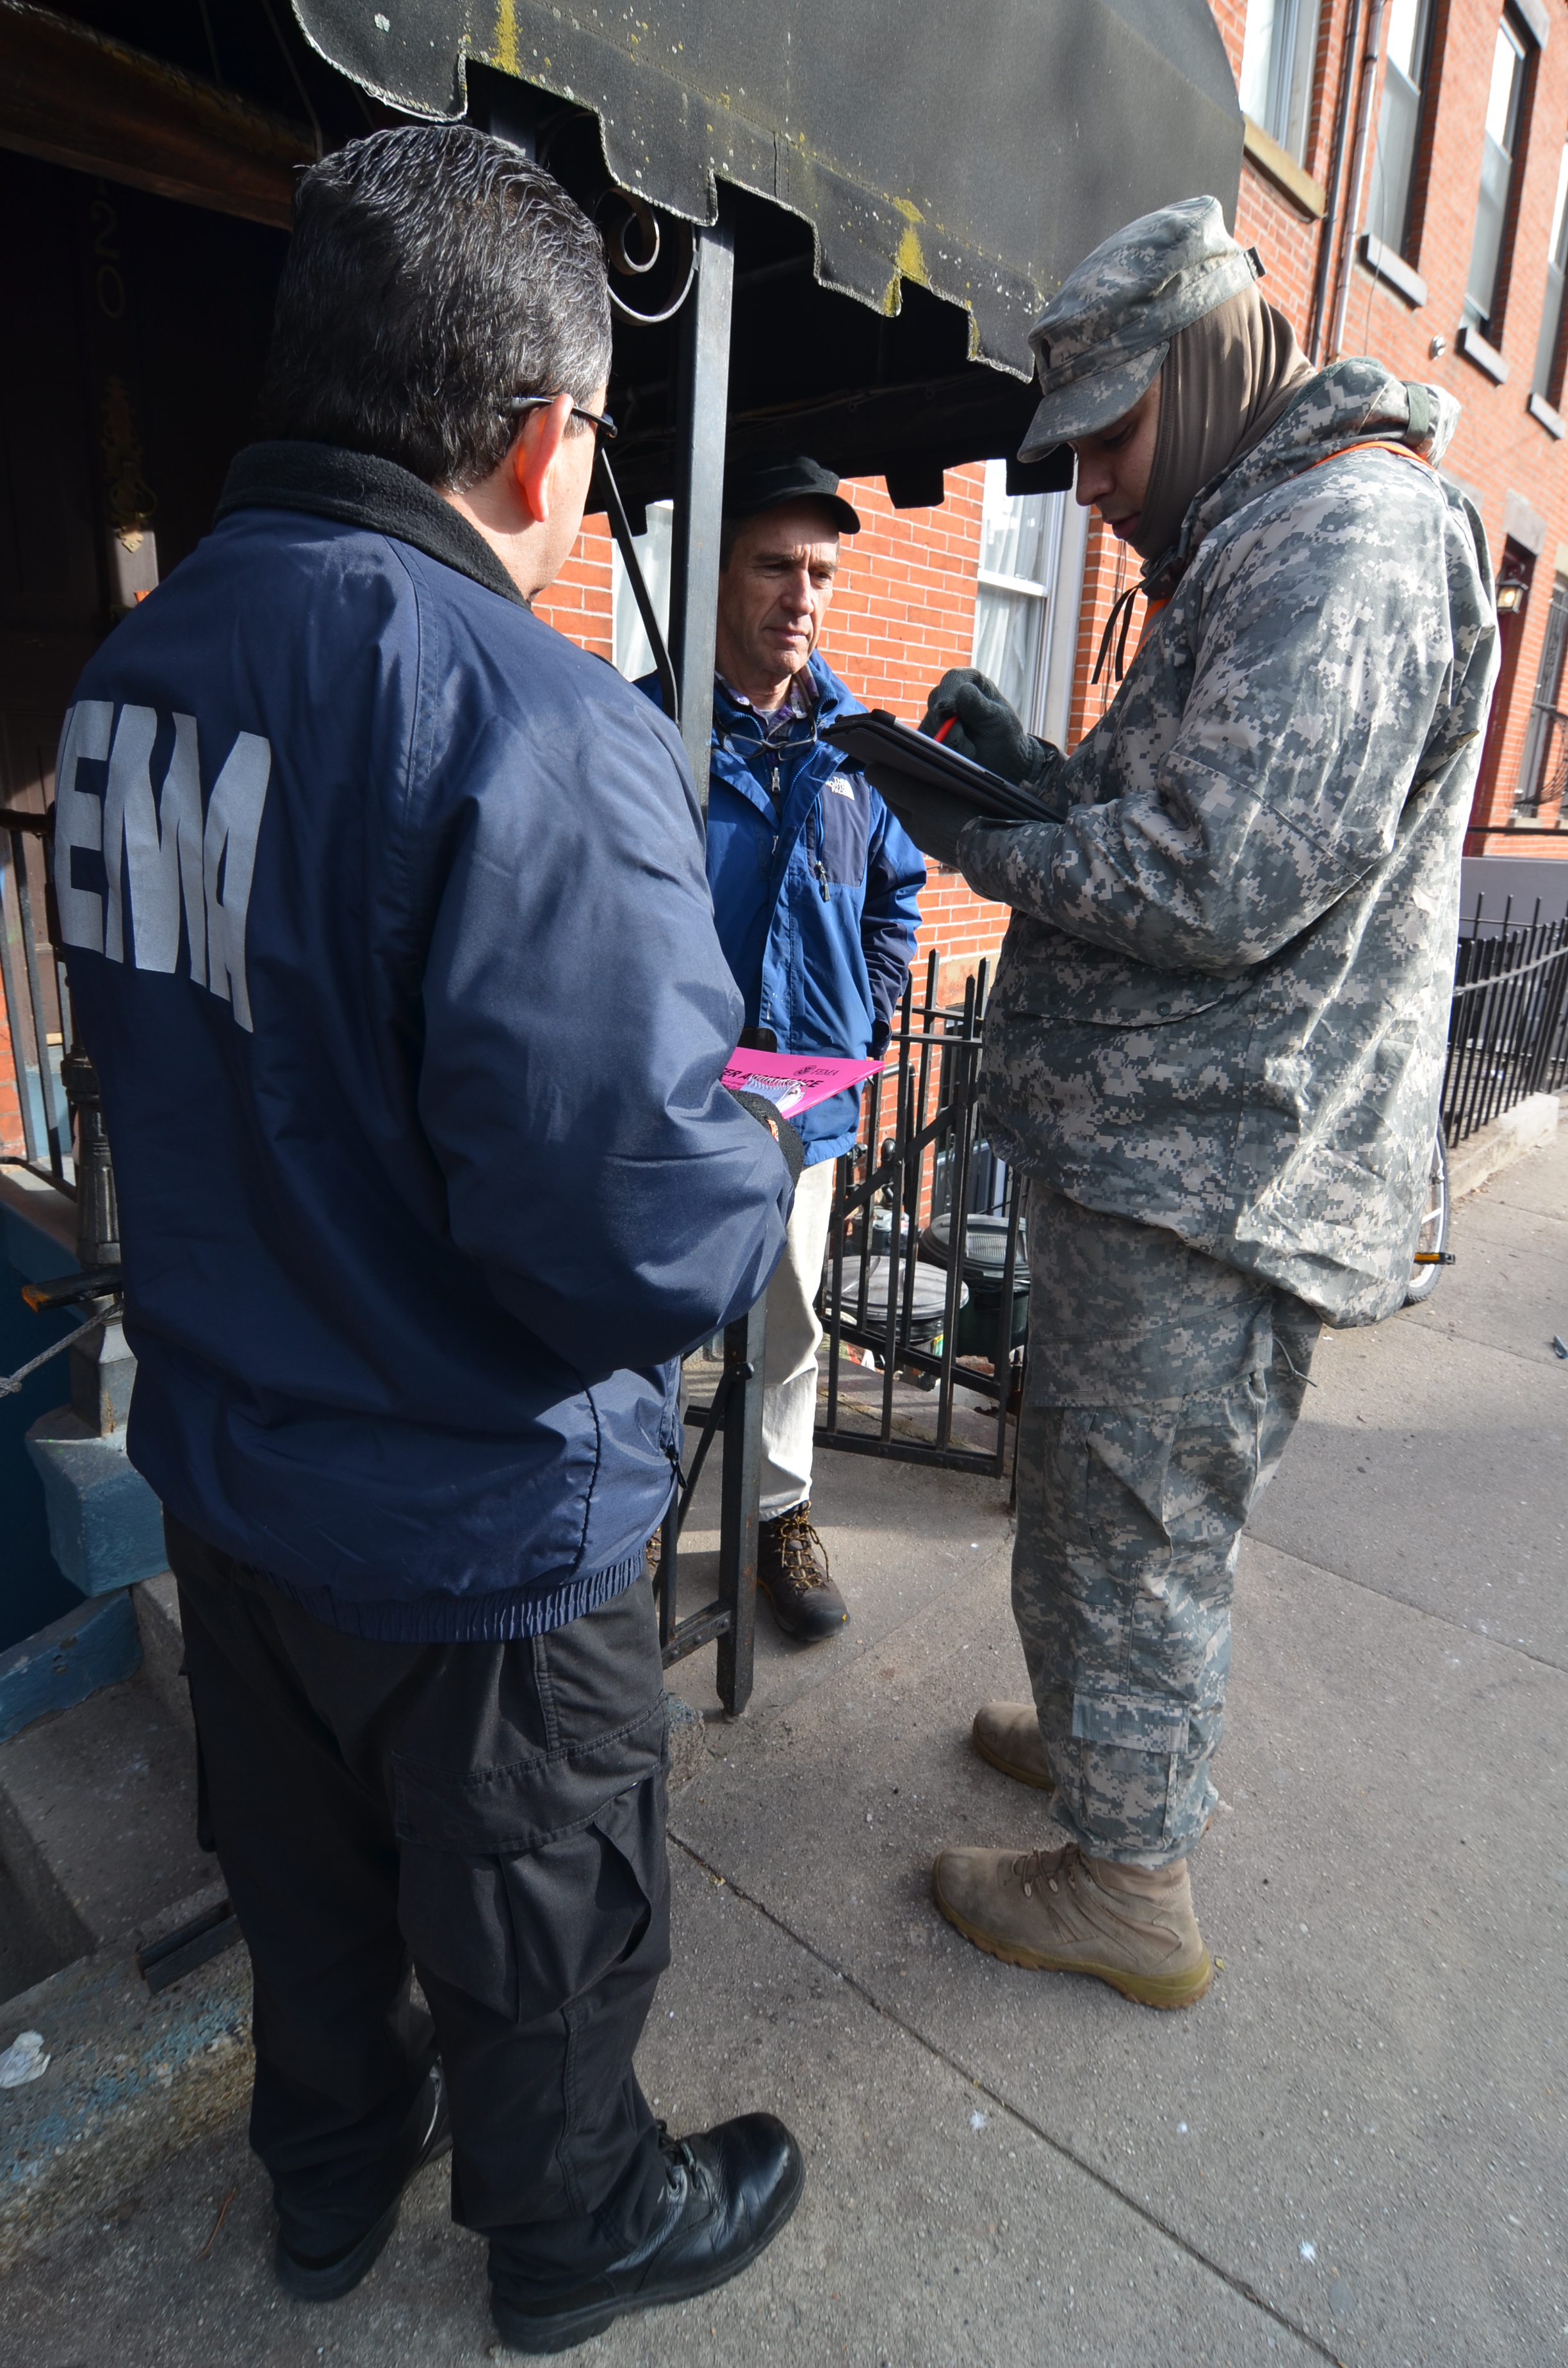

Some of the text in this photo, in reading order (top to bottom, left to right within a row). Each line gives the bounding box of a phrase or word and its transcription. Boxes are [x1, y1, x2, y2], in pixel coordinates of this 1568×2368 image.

[831, 786, 846, 795] FACE
[54, 700, 271, 1032] EMA
[737, 1073, 824, 1088] ASISTNCE
